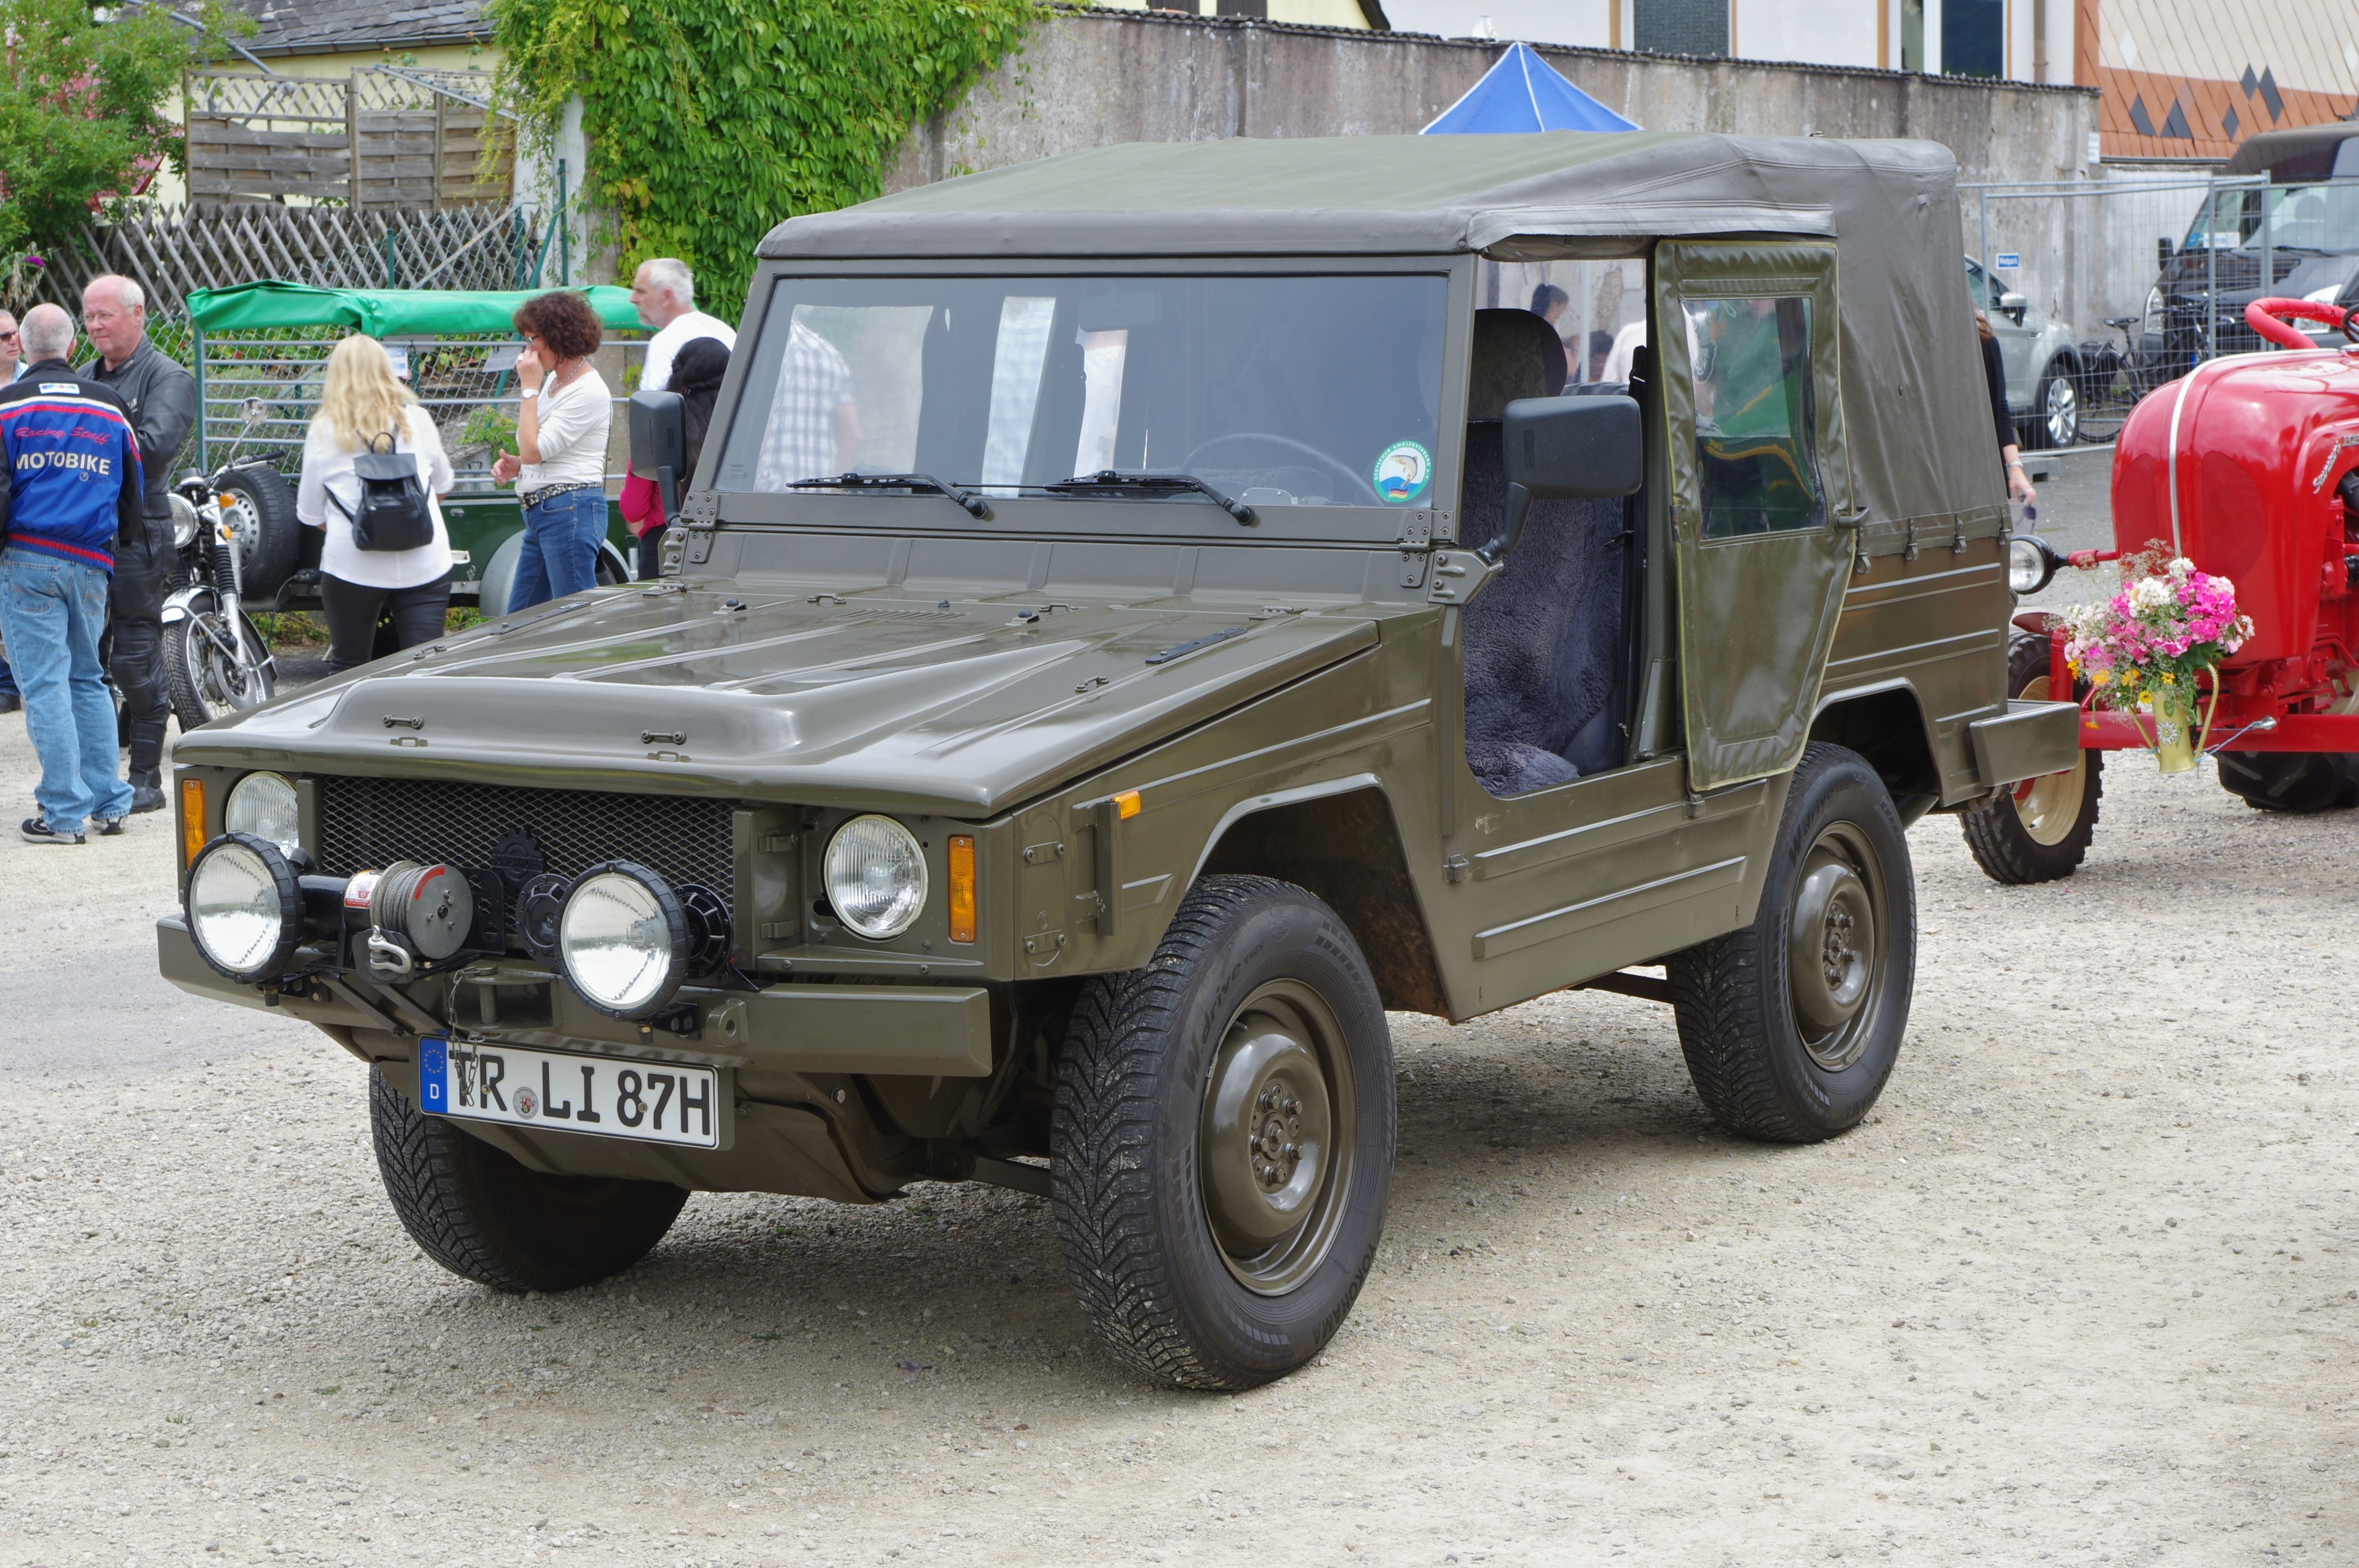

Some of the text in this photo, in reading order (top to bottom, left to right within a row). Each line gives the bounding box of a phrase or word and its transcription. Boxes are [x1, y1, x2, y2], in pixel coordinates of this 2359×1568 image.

[15, 428, 111, 445] Racing Stuff
[16, 451, 111, 476] MOTOBIKE
[1374, 449, 1391, 480] DEUTSCHER
[1393, 442, 1431, 466] ANGLERVERBAND
[491, 853, 544, 870] BOMBARDIER
[430, 1084, 439, 1100] D
[448, 1050, 508, 1112] TR
[541, 1060, 600, 1123] LI
[617, 1069, 711, 1136] 87H
[1312, 1243, 1376, 1345] YOKOHAMA
